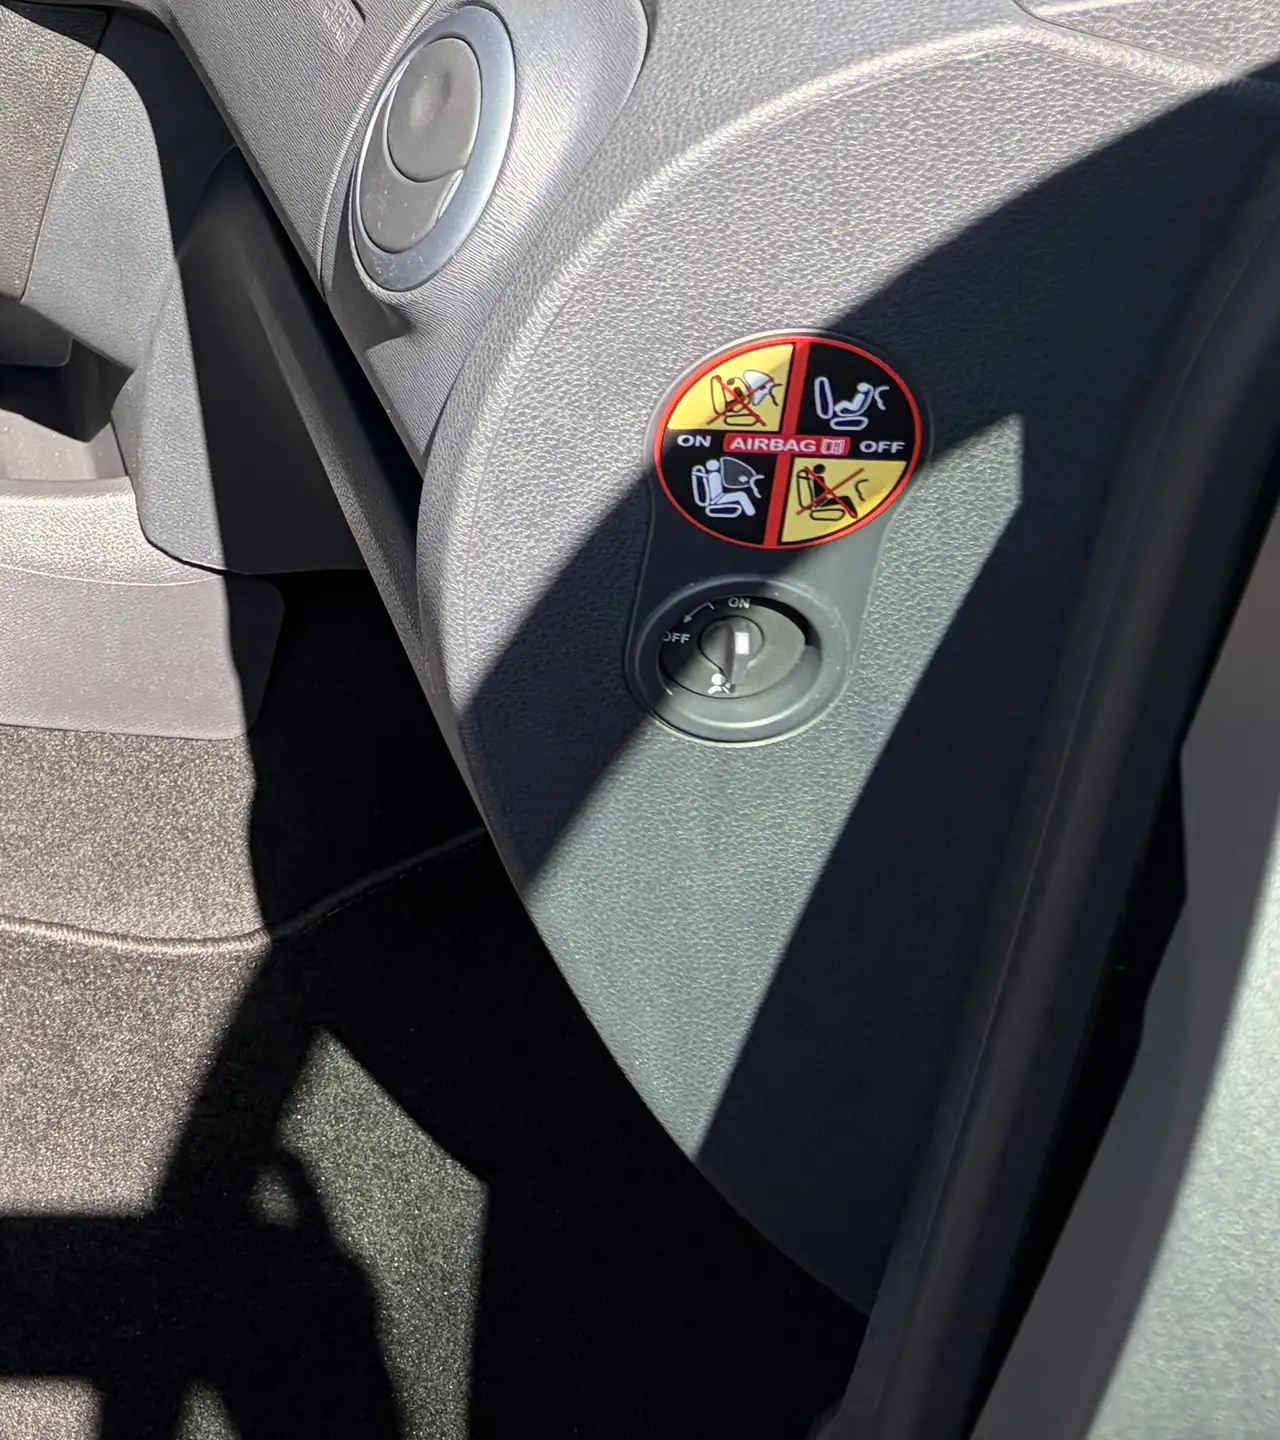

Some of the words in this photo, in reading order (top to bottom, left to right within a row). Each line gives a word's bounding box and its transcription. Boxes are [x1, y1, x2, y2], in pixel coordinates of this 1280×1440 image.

[676, 434, 712, 448] ON
[729, 436, 817, 452] AIRBAG
[858, 439, 906, 454] OFF
[727, 597, 751, 609] ON
